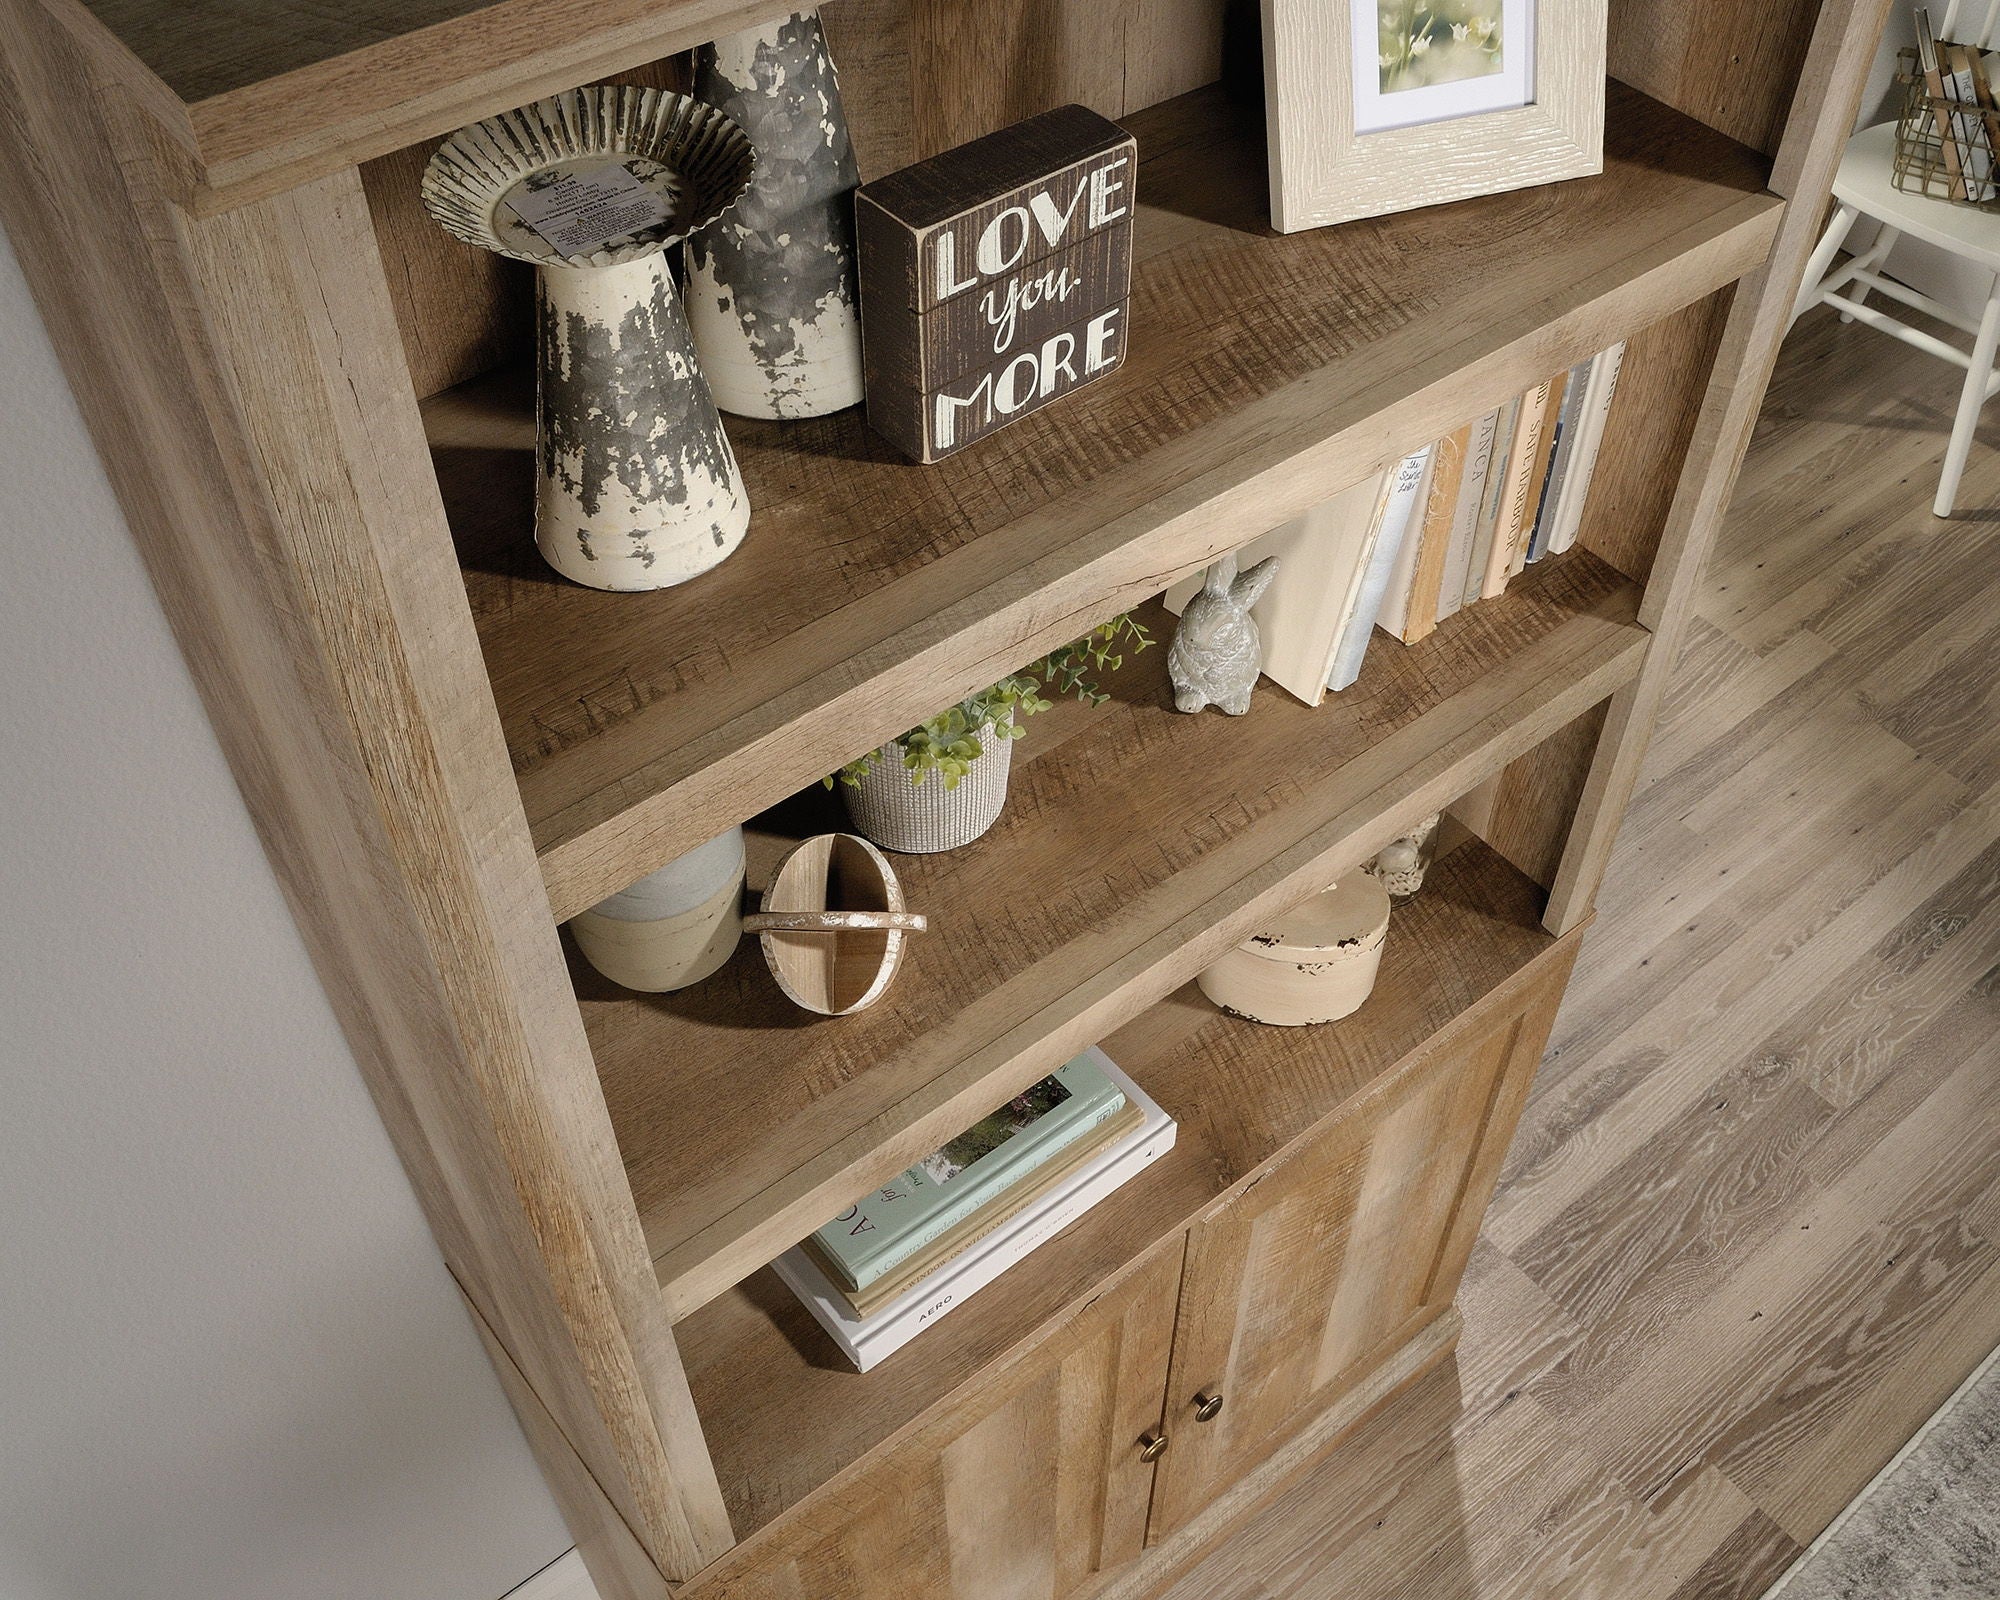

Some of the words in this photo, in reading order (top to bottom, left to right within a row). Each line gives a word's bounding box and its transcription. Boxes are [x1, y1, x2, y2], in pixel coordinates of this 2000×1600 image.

[556, 196, 578, 206] Hobby
[578, 188, 600, 198] Lobby
[936, 157, 1128, 300] LOVE
[979, 266, 1083, 354] you
[935, 308, 1120, 449] MORE
[1522, 419, 1541, 466] SAFE
[1505, 467, 1531, 552] HARBOUR
[879, 1188, 907, 1203] for
[884, 1242, 922, 1271] Country
[924, 1217, 958, 1243] Garden
[960, 1206, 973, 1221] for
[975, 1192, 998, 1208] Your
[998, 1161, 1037, 1196] Backyard
[907, 1258, 946, 1288] WINDOW
[918, 1295, 953, 1323] AERO
